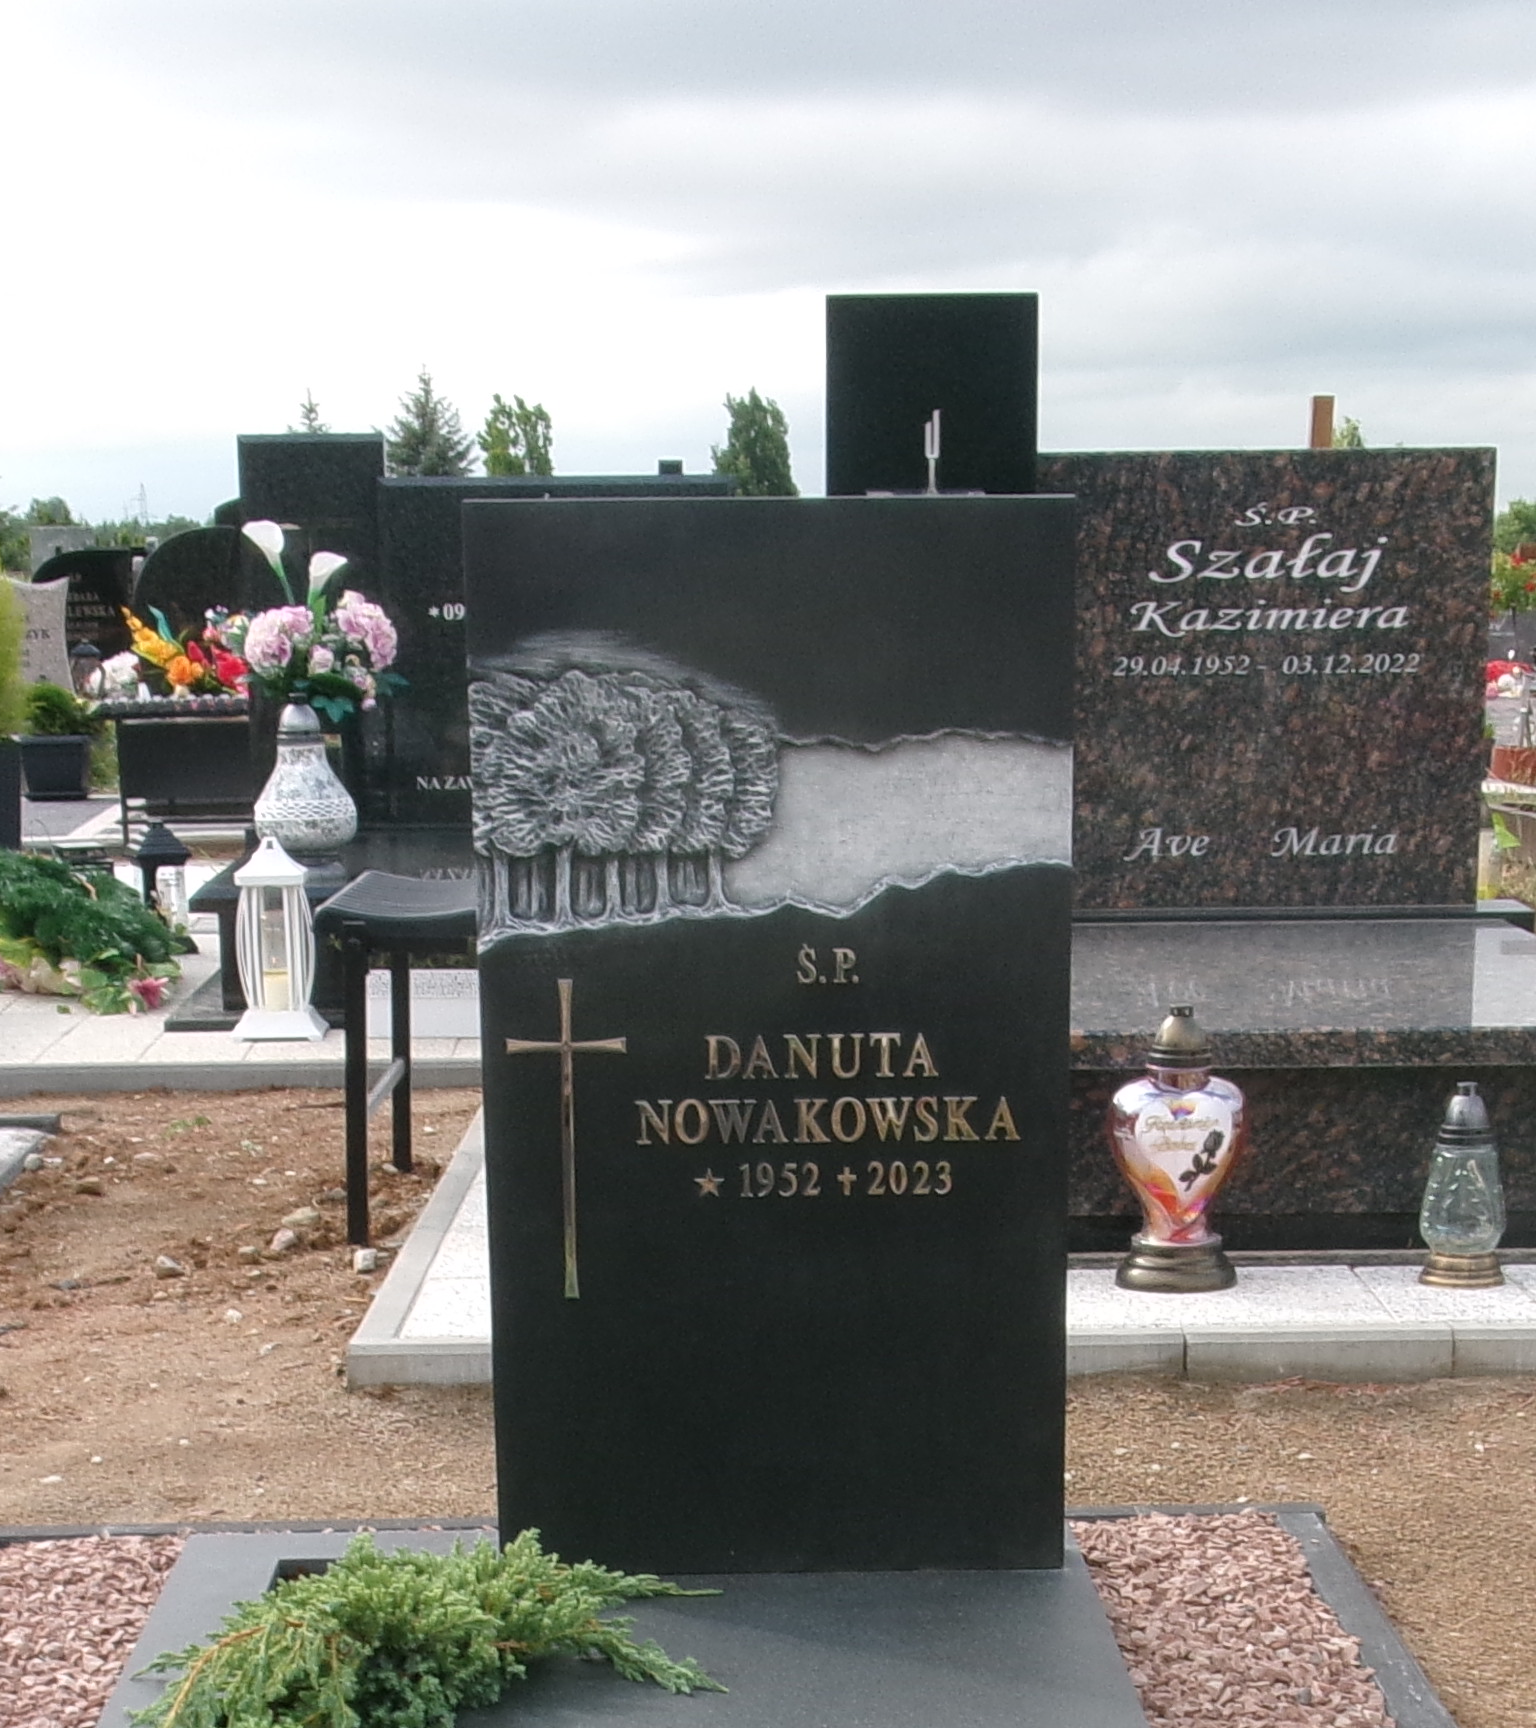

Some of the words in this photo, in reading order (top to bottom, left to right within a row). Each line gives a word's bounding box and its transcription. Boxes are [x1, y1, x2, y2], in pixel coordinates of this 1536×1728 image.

[1234, 502, 1317, 527] Ś.P.
[1148, 533, 1388, 593] Szałaj
[1130, 599, 1409, 638] Kazimiera
[1113, 655, 1250, 677] 29.04.1952
[1282, 653, 1420, 676] 03.12.2022
[1123, 827, 1211, 862] Ave
[1271, 824, 1398, 857] Maria
[703, 1032, 939, 1081] DANUTA
[634, 1096, 1021, 1146] NOWAKOWSKA
[738, 1161, 822, 1199] 1952
[866, 1160, 953, 1197] 2023
